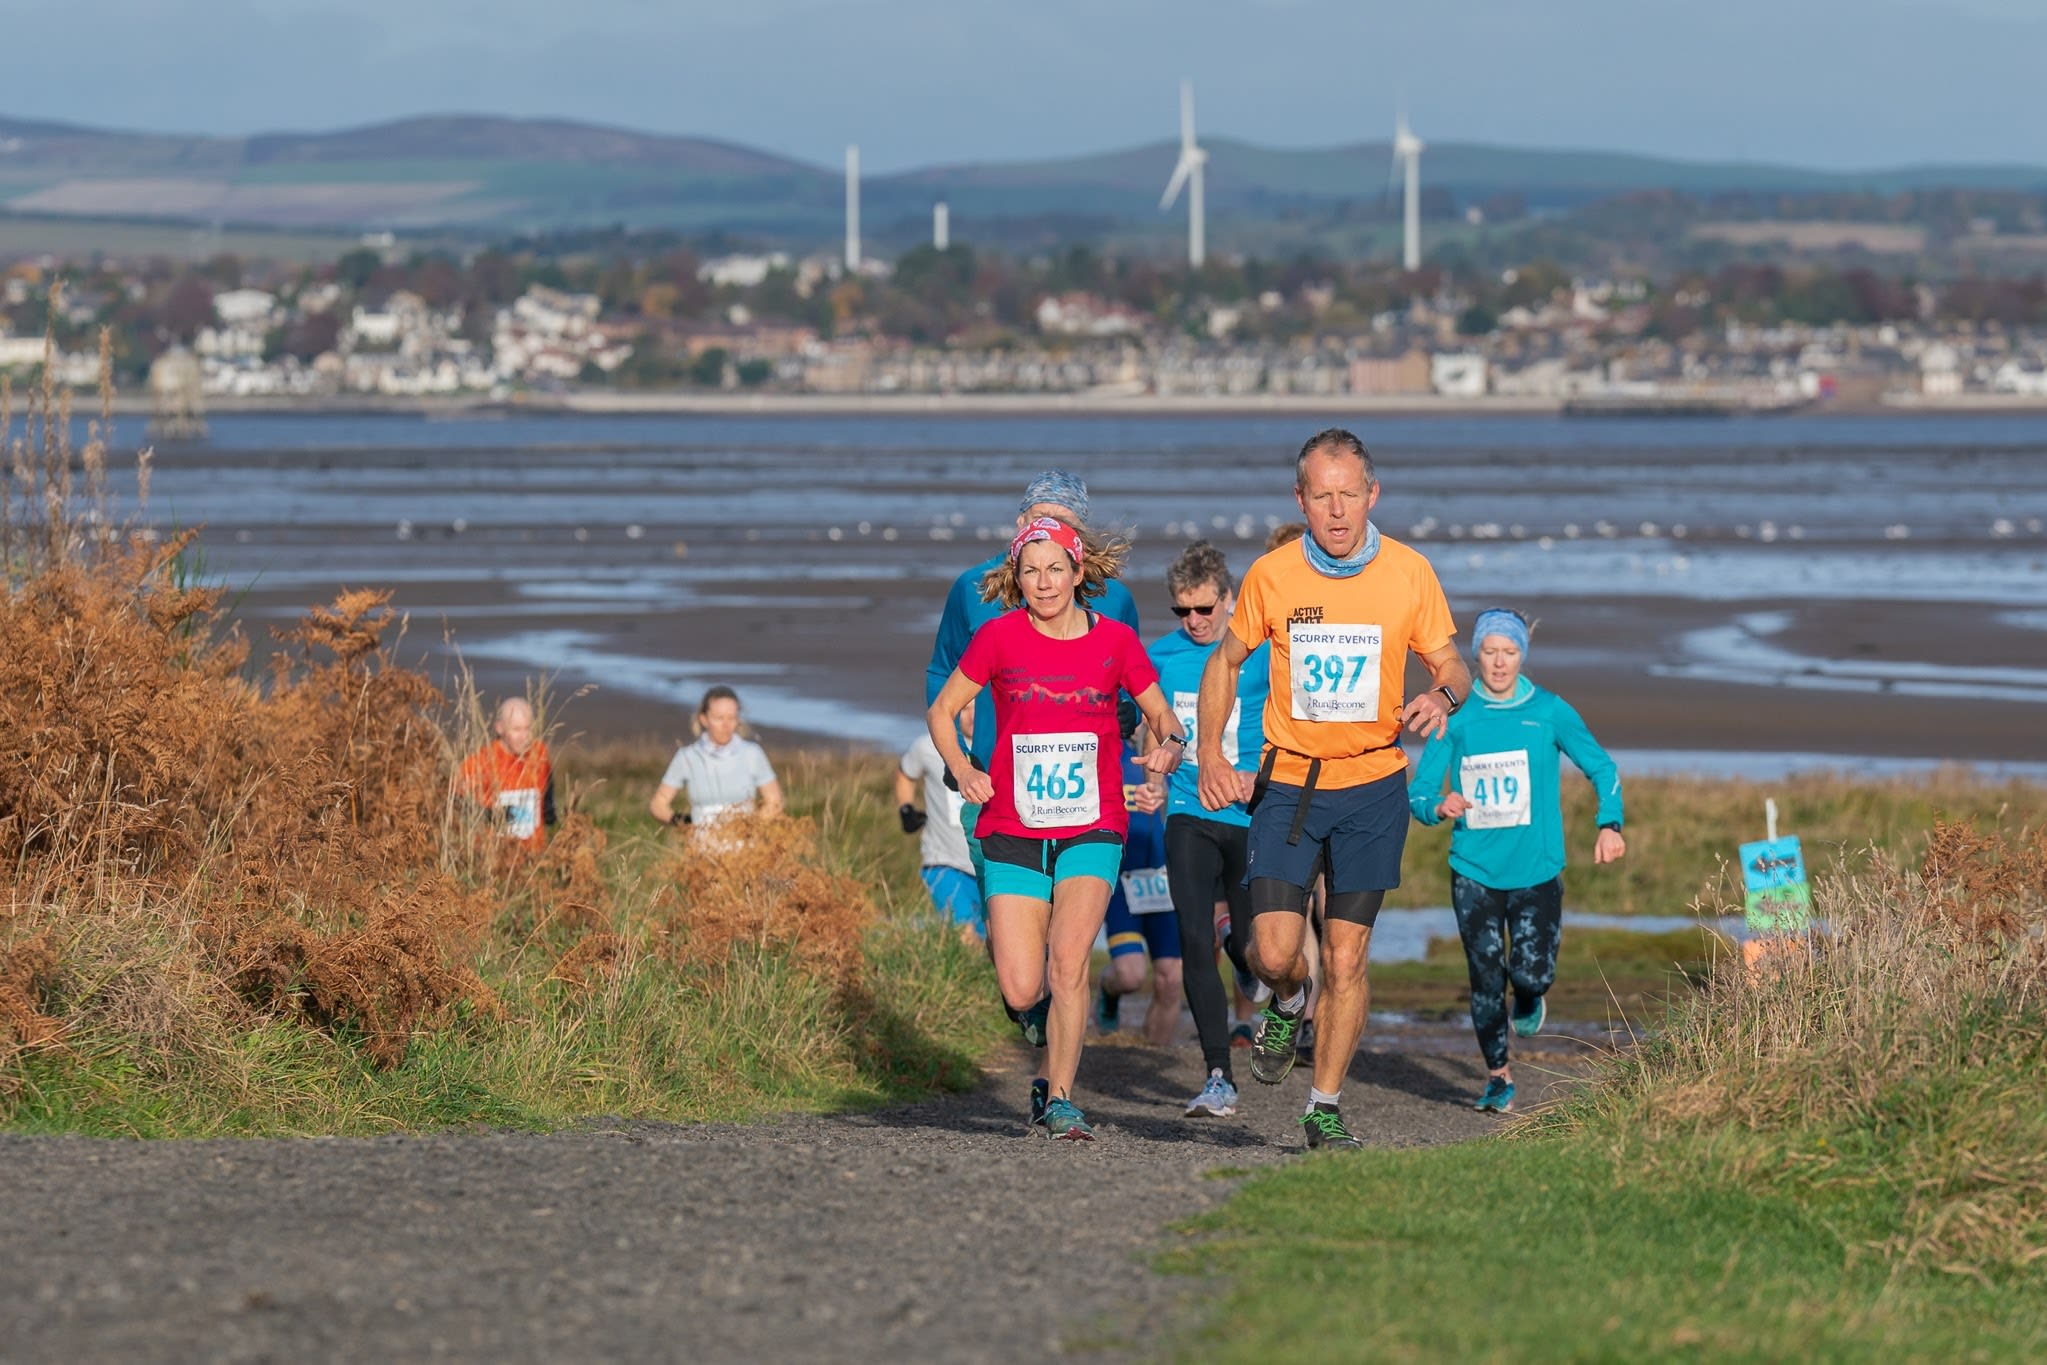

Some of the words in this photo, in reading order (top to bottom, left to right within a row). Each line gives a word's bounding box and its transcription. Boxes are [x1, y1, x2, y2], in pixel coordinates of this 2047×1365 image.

[1293, 606, 1324, 617] ACTIVE
[1292, 633, 1335, 643] SCURRY
[1338, 634, 1380, 645] EVENTS
[1302, 653, 1368, 694] 397
[1016, 744, 1055, 754] SCURRY
[1058, 742, 1097, 752] EVENTS
[1026, 761, 1085, 801] 465
[1474, 775, 1519, 807] 419
